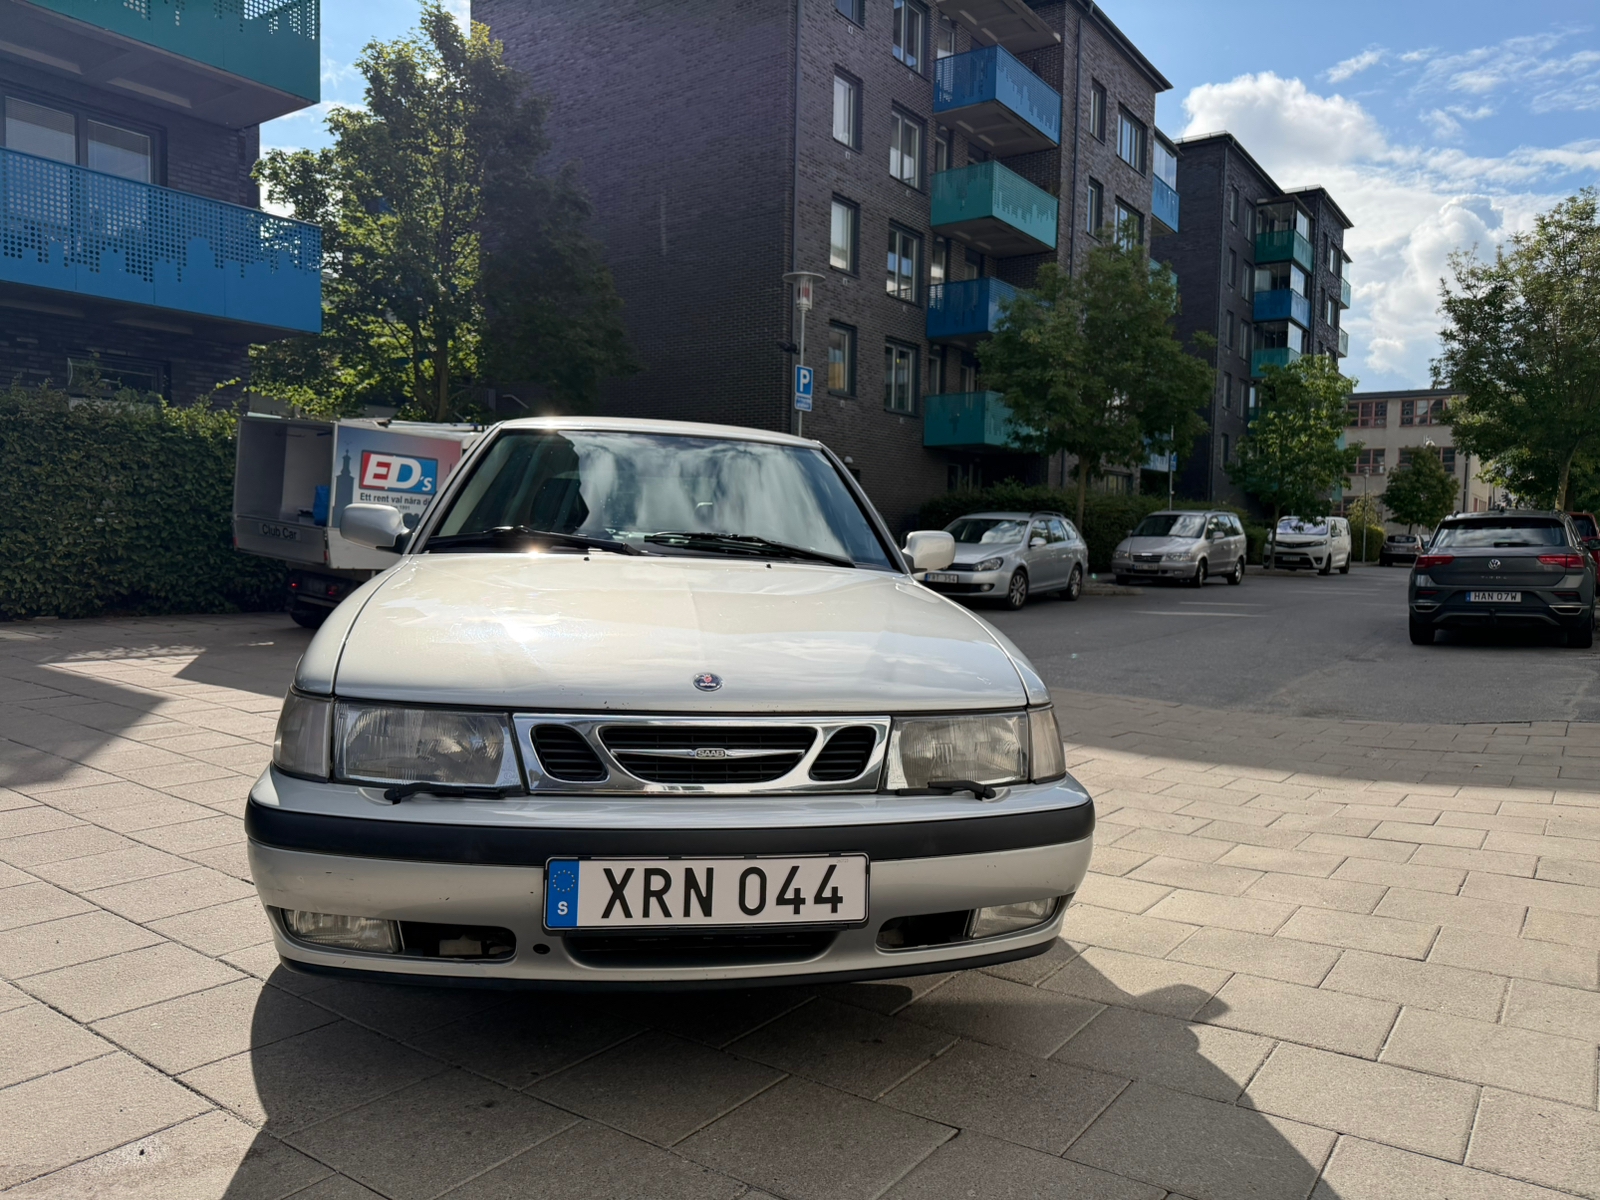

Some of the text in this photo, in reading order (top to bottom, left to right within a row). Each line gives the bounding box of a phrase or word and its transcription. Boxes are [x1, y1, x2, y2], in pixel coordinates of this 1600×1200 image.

[800, 369, 810, 392] P
[360, 492, 372, 502] Ett
[373, 494, 389, 504] rent
[391, 495, 402, 504] val
[404, 497, 421, 505] nära
[262, 523, 297, 540] Club Car
[1473, 592, 1494, 601] HAN
[1496, 592, 1517, 601] 07W
[697, 750, 725, 758] SAAB
[601, 864, 844, 919] XRN 044
[557, 901, 568, 915] S
